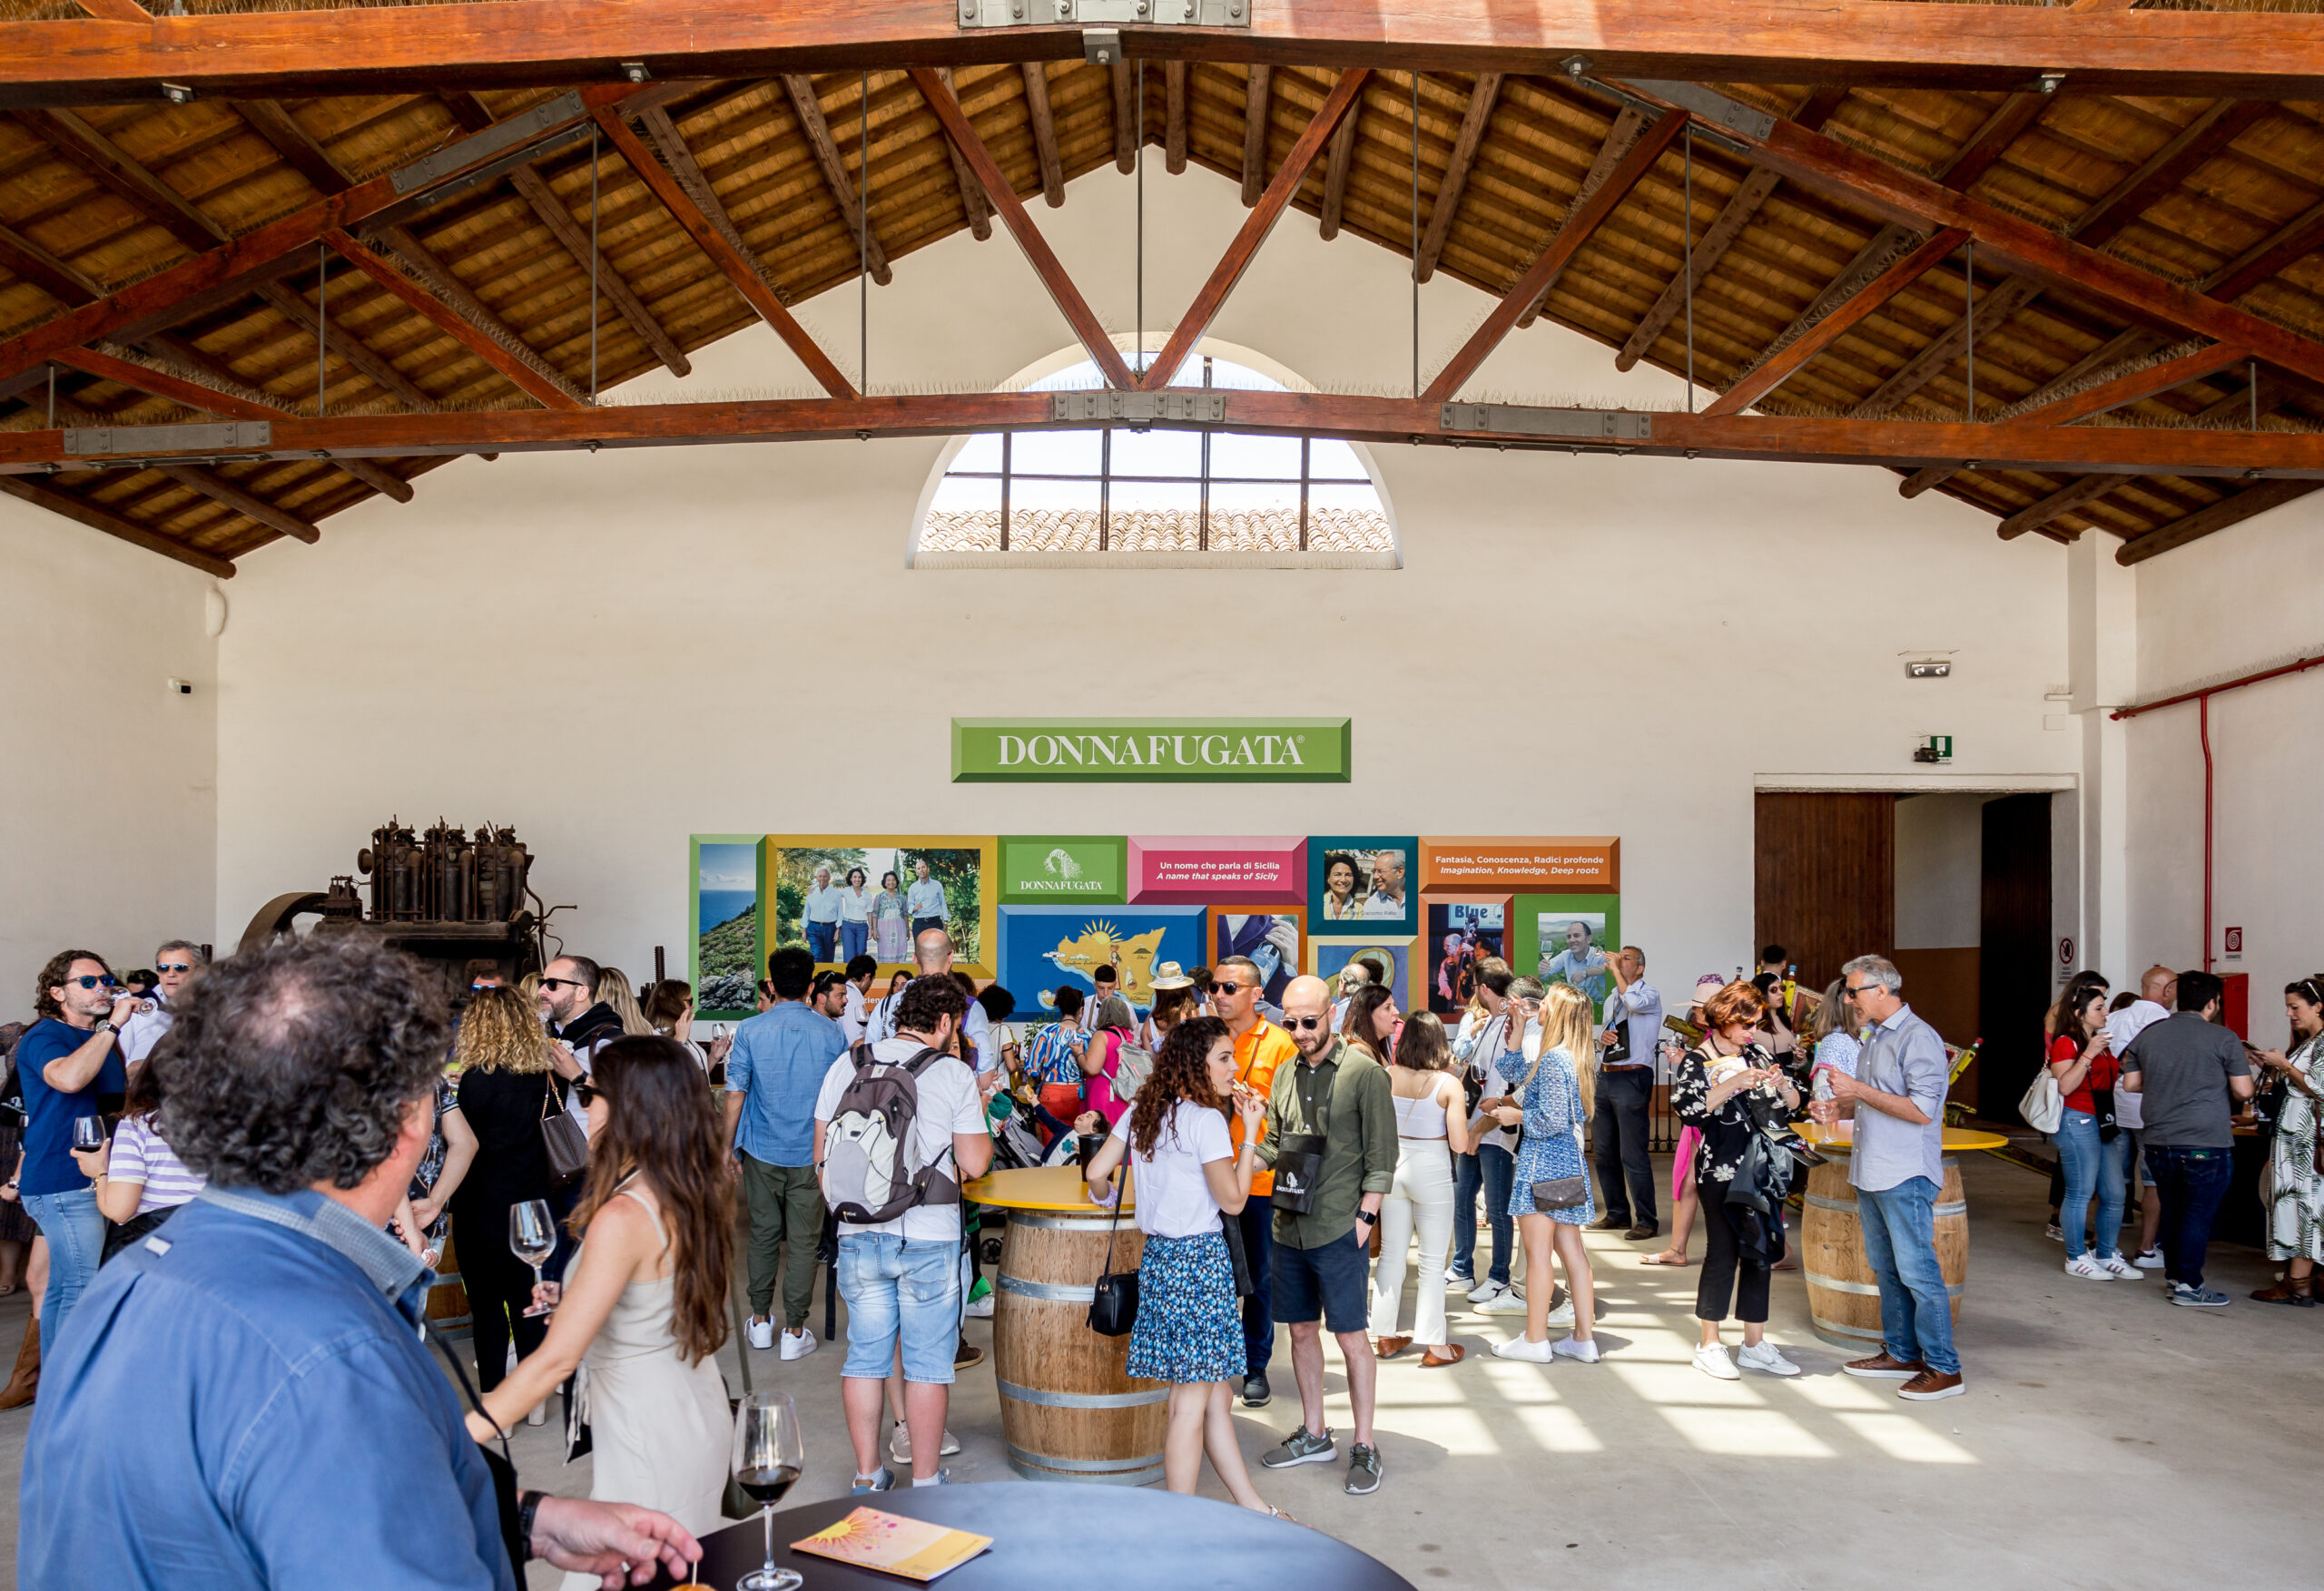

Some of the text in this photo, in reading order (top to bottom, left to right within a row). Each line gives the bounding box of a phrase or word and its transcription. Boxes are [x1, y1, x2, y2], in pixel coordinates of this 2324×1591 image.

[1435, 856, 1604, 865] Fantasia, Conoscenza, Radici profonde
[1160, 861, 1172, 869] Un
[1201, 861, 1216, 869] che
[1218, 861, 1241, 871] parla
[1243, 861, 1252, 869] di
[1254, 861, 1280, 869] Sicilia
[1440, 867, 1494, 876] Imagination,
[1497, 867, 1548, 876] Knowledge,
[1551, 867, 1574, 876] Deep
[1156, 872, 1164, 880] A
[1191, 872, 1210, 880] that
[1211, 872, 1241, 881] speaks
[1243, 872, 1254, 880] of
[1255, 872, 1278, 881] Sicily
[1019, 880, 1103, 890] DONNAFUGATA
[1454, 905, 1488, 918] Blue
